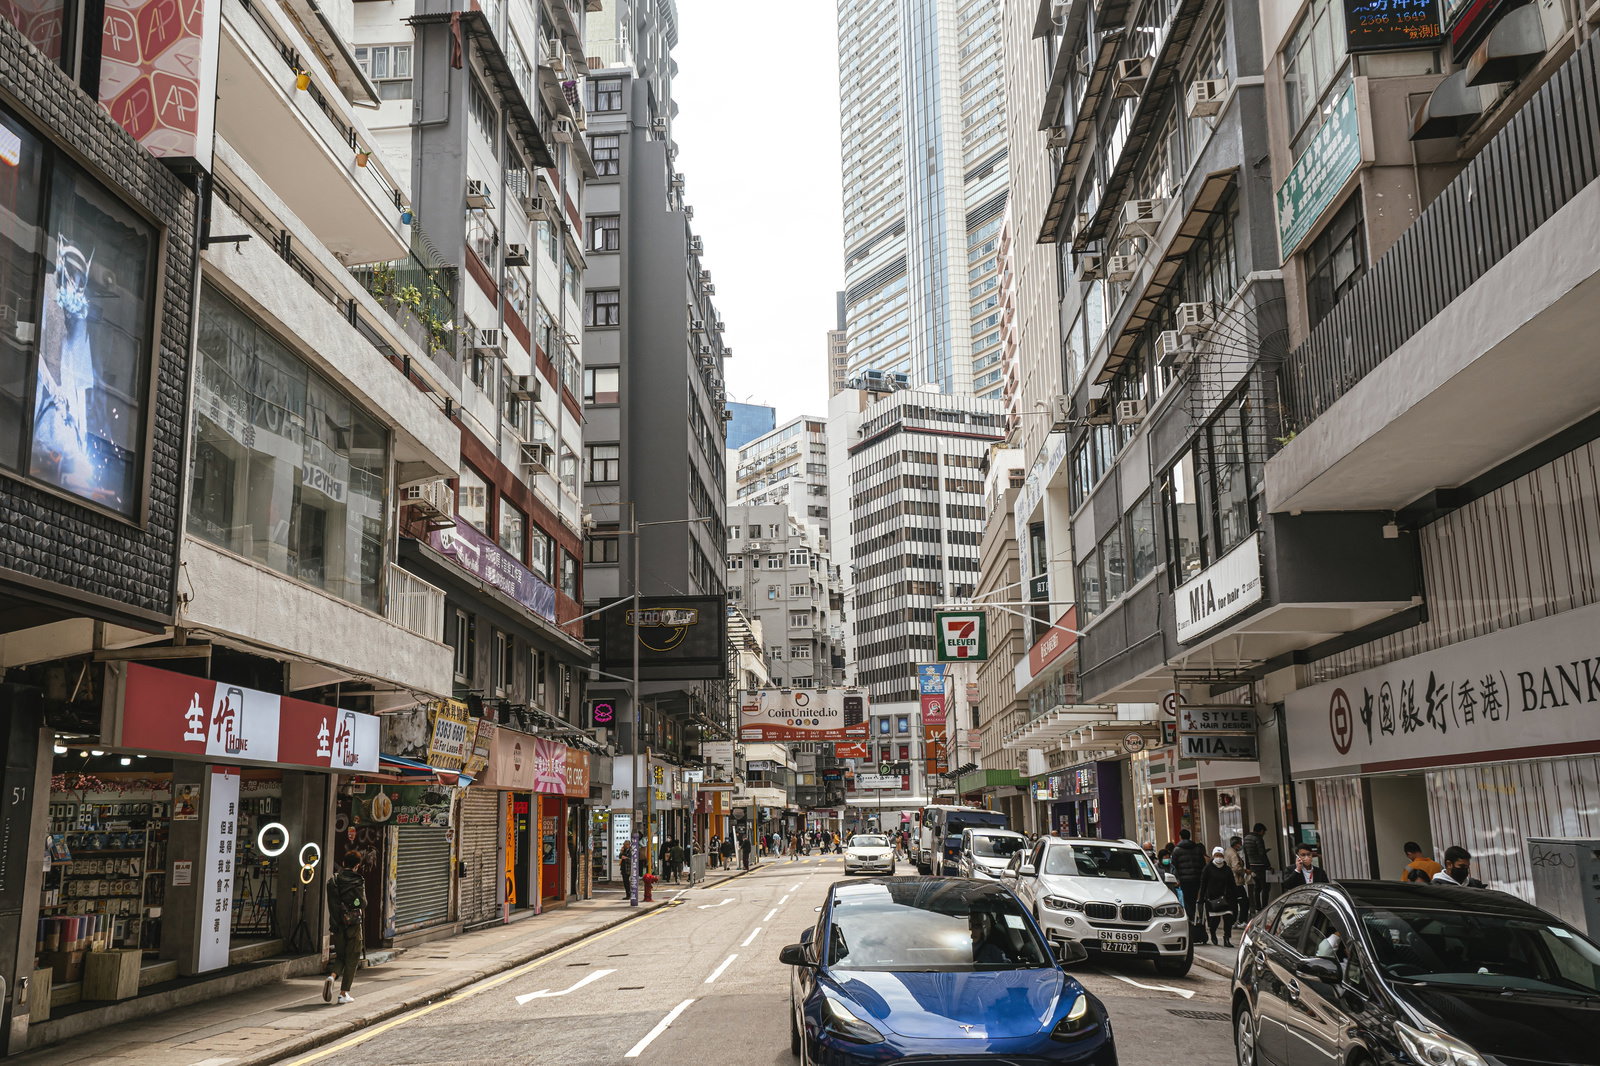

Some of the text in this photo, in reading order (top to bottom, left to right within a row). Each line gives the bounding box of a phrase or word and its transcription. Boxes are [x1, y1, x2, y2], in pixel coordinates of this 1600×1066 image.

[1189, 578, 1216, 625] MIA
[1217, 597, 1227, 611] for
[1227, 588, 1240, 605] hair
[948, 621, 975, 657] 7
[1517, 655, 1600, 713] BANK
[768, 707, 838, 719] CoinUnited.io
[1202, 711, 1249, 722] STYLE
[436, 720, 452, 740] 9363
[1200, 722, 1252, 730] HAIR DESIGN
[446, 743, 459, 754] Lease
[1188, 738, 1228, 754] MIA
[12, 787, 26, 805] 51
[1101, 932, 1139, 941] SN 6899
